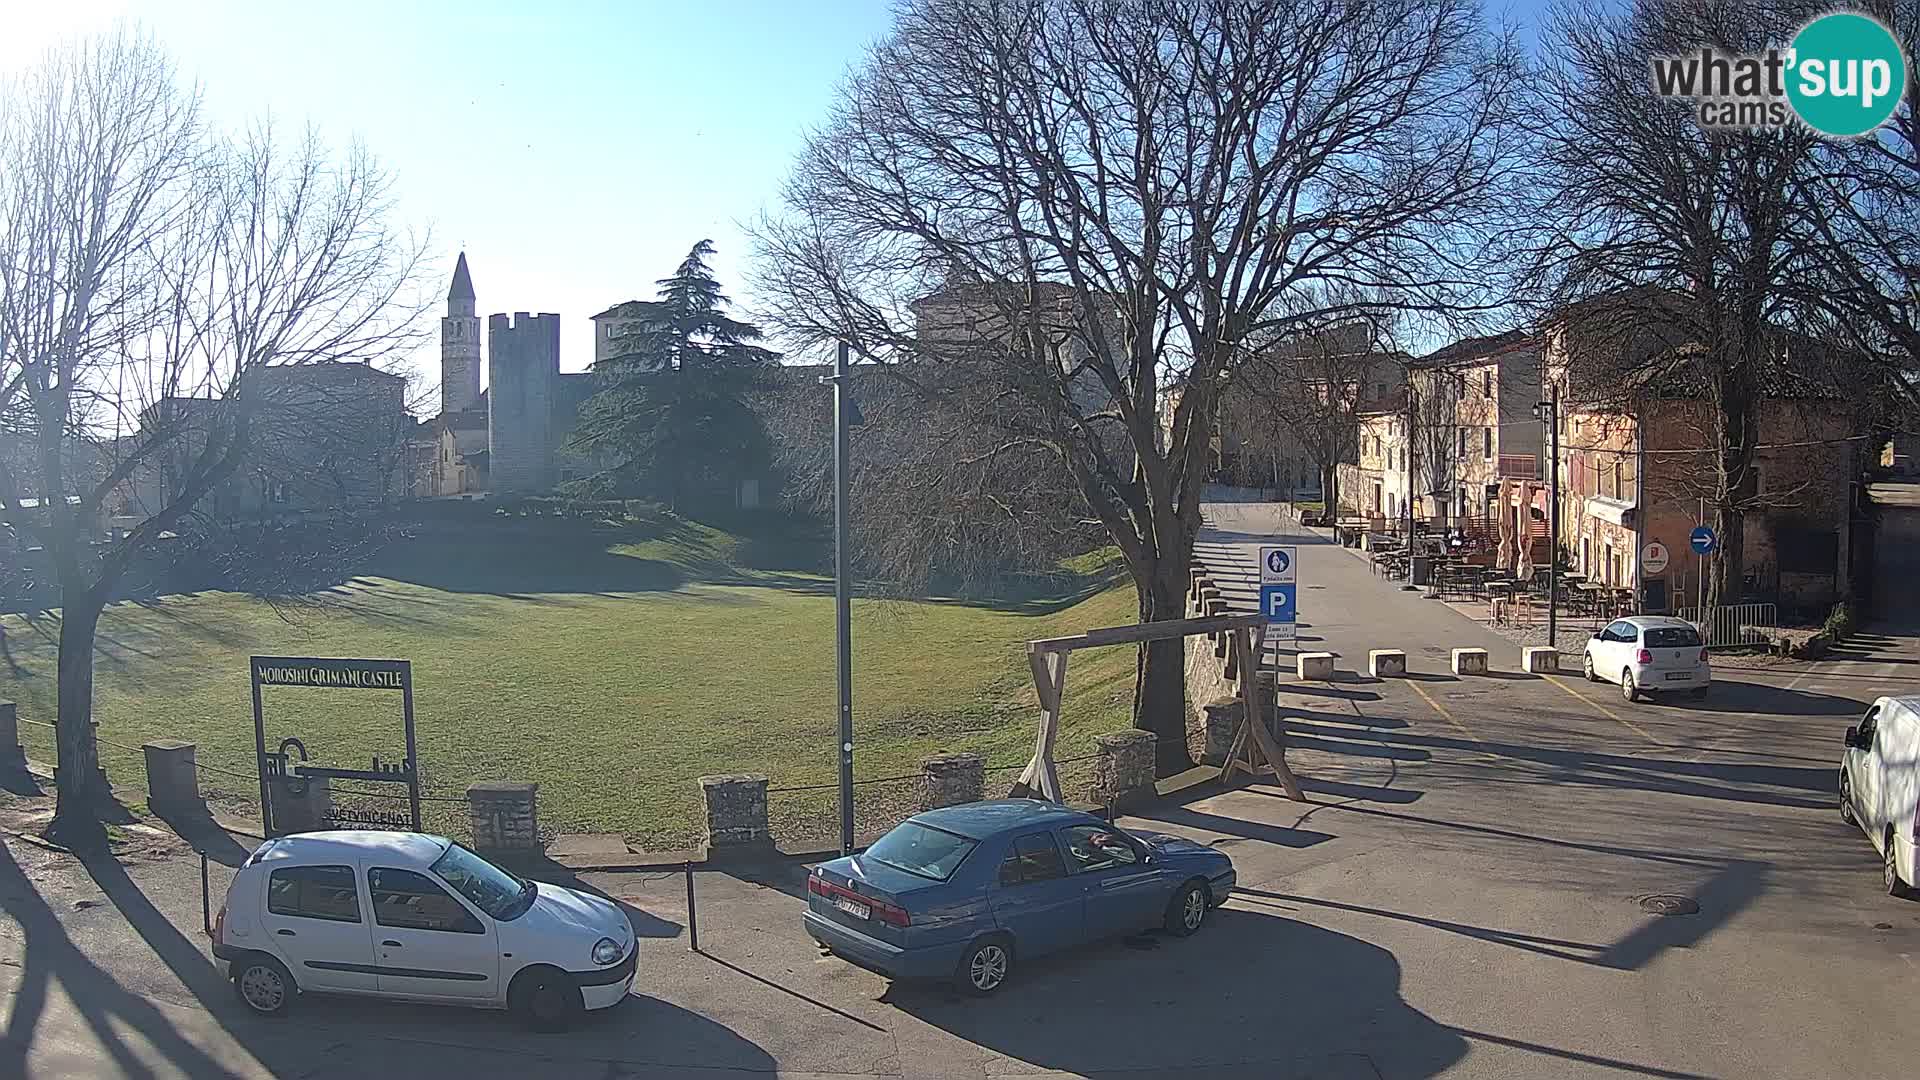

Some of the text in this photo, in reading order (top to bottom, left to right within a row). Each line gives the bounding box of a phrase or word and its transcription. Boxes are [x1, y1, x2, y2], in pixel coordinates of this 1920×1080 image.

[1270, 592, 1287, 616] P
[258, 665, 403, 688] MOROSINI GRIMANI CASTLE
